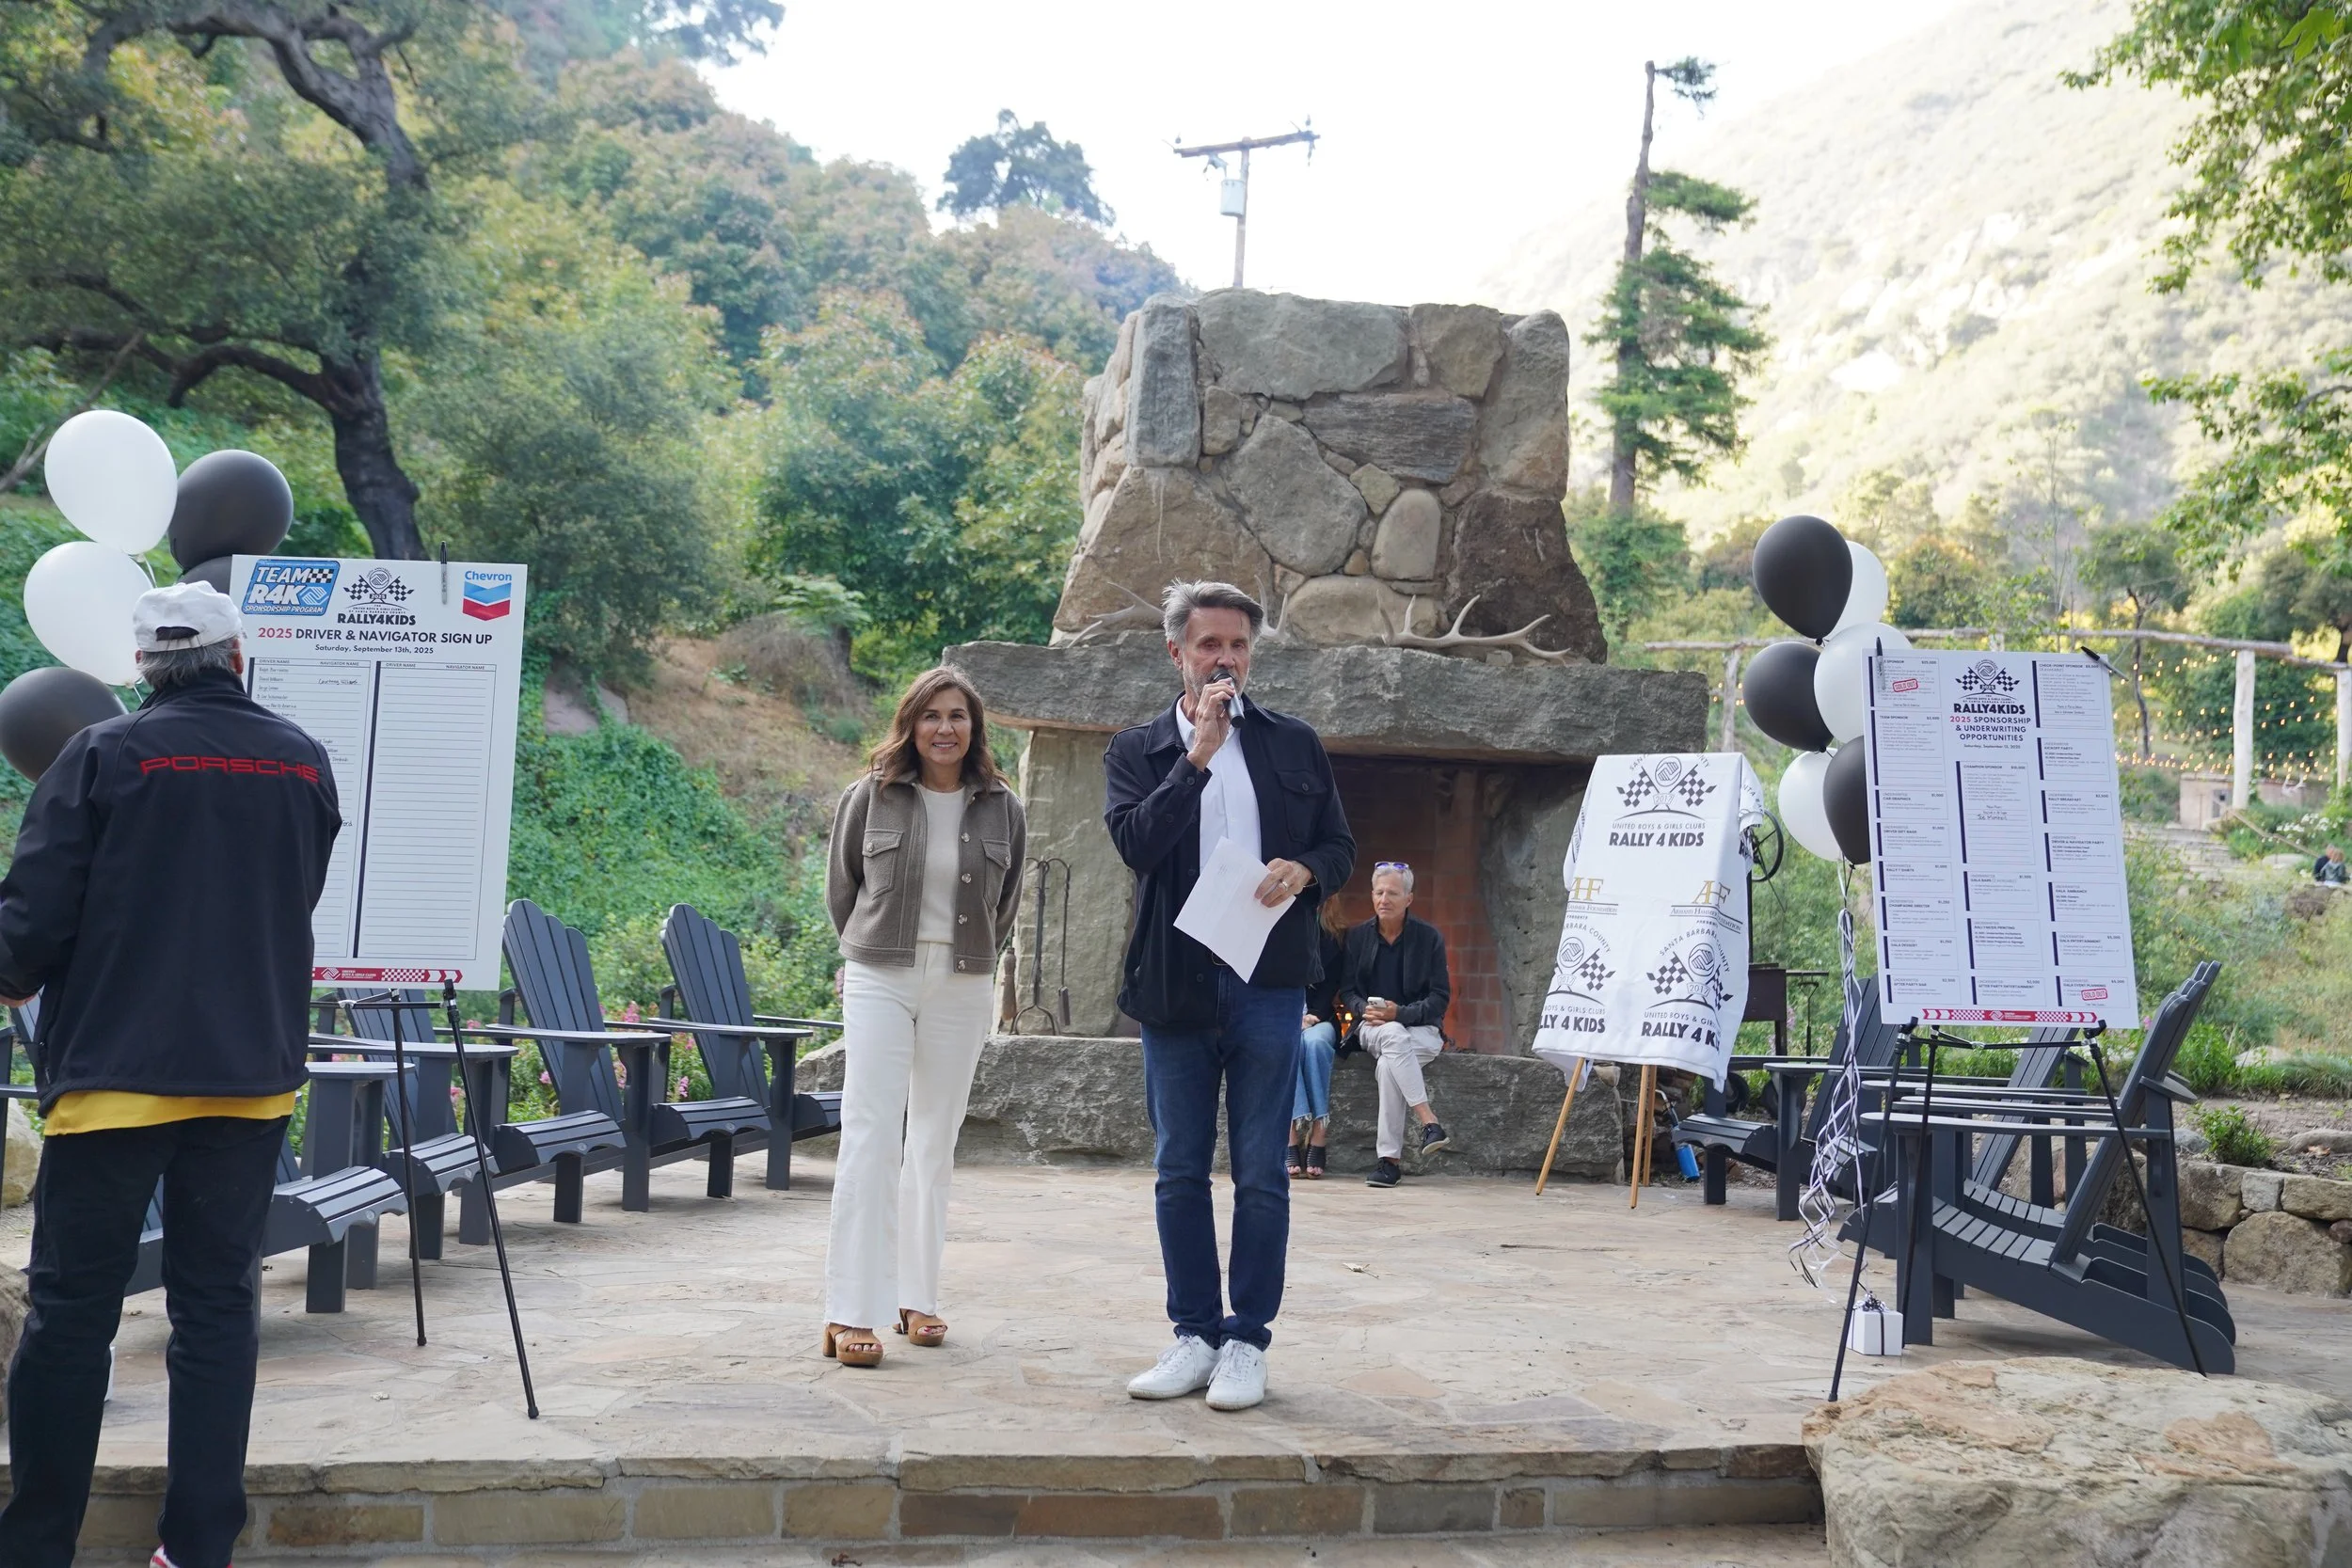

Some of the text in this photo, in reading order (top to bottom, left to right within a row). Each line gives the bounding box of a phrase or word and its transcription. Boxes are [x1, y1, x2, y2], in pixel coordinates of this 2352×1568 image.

[257, 566, 310, 583] TEAM
[464, 570, 512, 581] Chevron
[247, 583, 307, 605] R4K
[245, 605, 324, 614] SPONSORSHIP PROGRAM
[337, 612, 417, 626] RALLY4KIDS
[258, 627, 493, 644] 2025 DRIVER & NAVIGATOR SIGN UP
[315, 644, 352, 653] Saturday,
[353, 645, 392, 654] September
[1894, 682, 1907, 690] SOLD
[1953, 703, 2026, 715] RALLY4KIDS
[1974, 716, 2031, 724] SPONSORSHIP
[140, 755, 319, 784] PORSCHE
[1654, 795, 1674, 804] 2017
[1609, 832, 1705, 847] RALLY 4 KIDS
[1589, 927, 1611, 953] COUNTY
[1660, 935, 1683, 957] SANTA
[1689, 984, 1710, 995] 2017
[1567, 1006, 1586, 1014] GIRLS
[1670, 1012, 1689, 1021] BOYS
[1561, 1016, 1570, 1030] 4
[1573, 1016, 1606, 1033] KIDS
[1641, 1022, 1689, 1038] RALLY
[1691, 1027, 1703, 1042] 4
